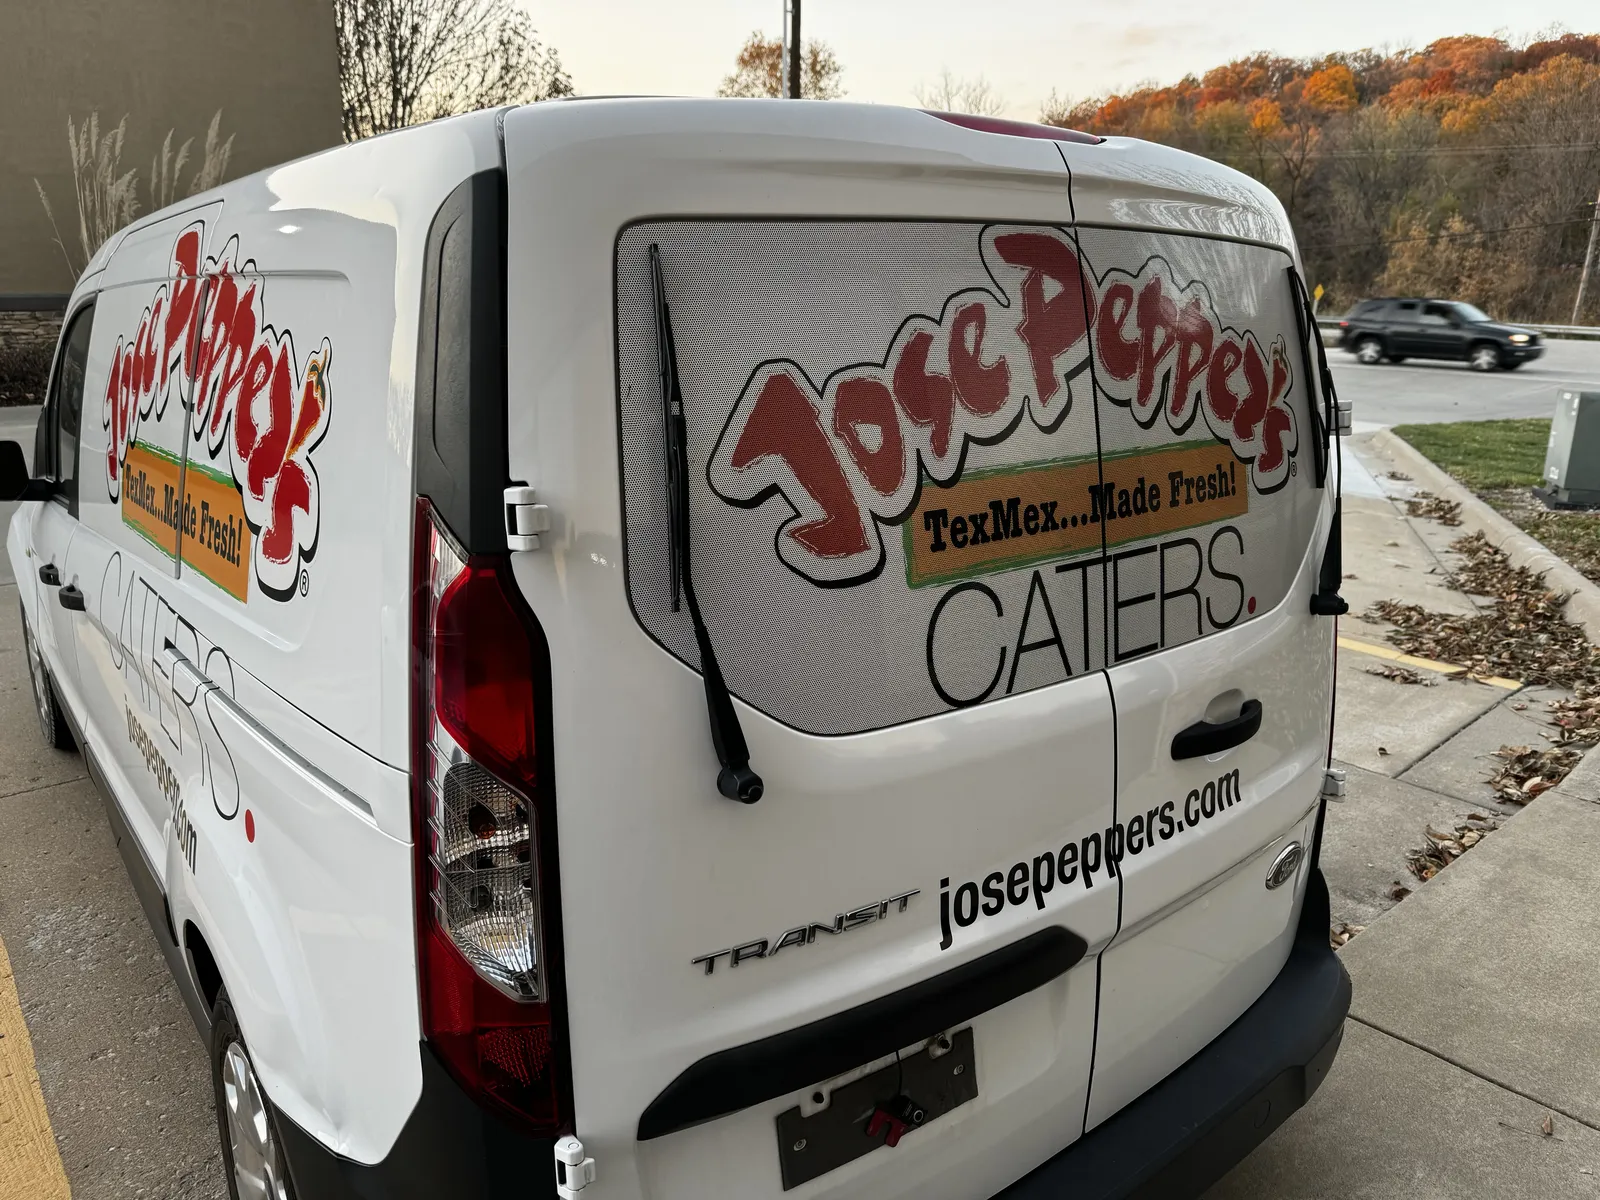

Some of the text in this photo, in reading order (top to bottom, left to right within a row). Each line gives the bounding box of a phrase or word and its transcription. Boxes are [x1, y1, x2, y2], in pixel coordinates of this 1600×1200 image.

[731, 301, 1011, 558] Jose
[199, 500, 242, 568] Fresh!
[923, 461, 1237, 553] TexMex...Made Fresh!
[938, 766, 1243, 951] josepeppers.com
[691, 888, 921, 976] TRANSIT
